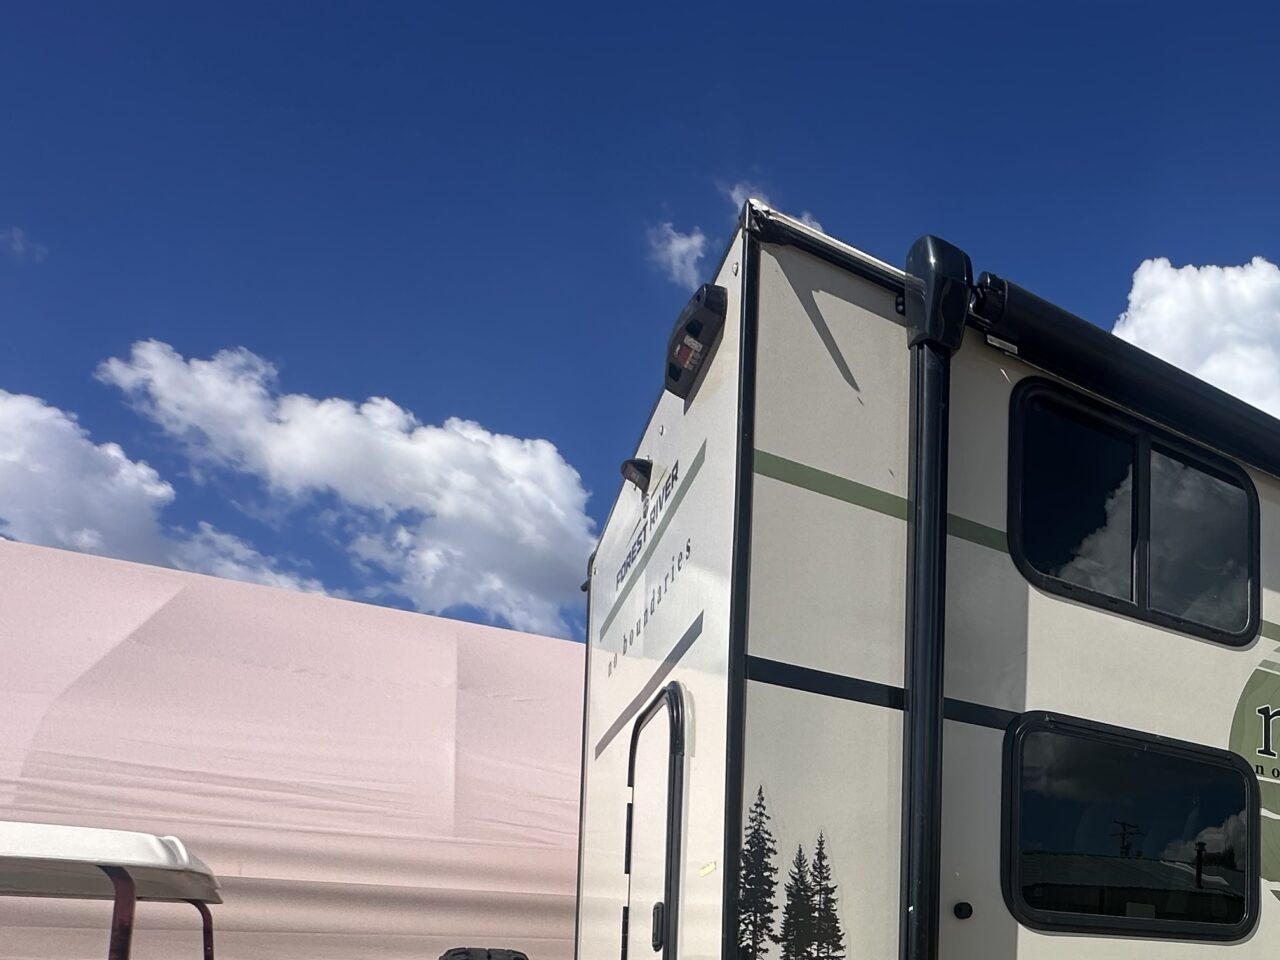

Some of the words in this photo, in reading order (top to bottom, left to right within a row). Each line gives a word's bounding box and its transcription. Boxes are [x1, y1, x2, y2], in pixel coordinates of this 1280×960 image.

[616, 520, 649, 592] FOREST
[649, 459, 679, 531] RIVER
[607, 653, 618, 678] no
[622, 538, 691, 656] boundaries
[1255, 764, 1280, 779] no
